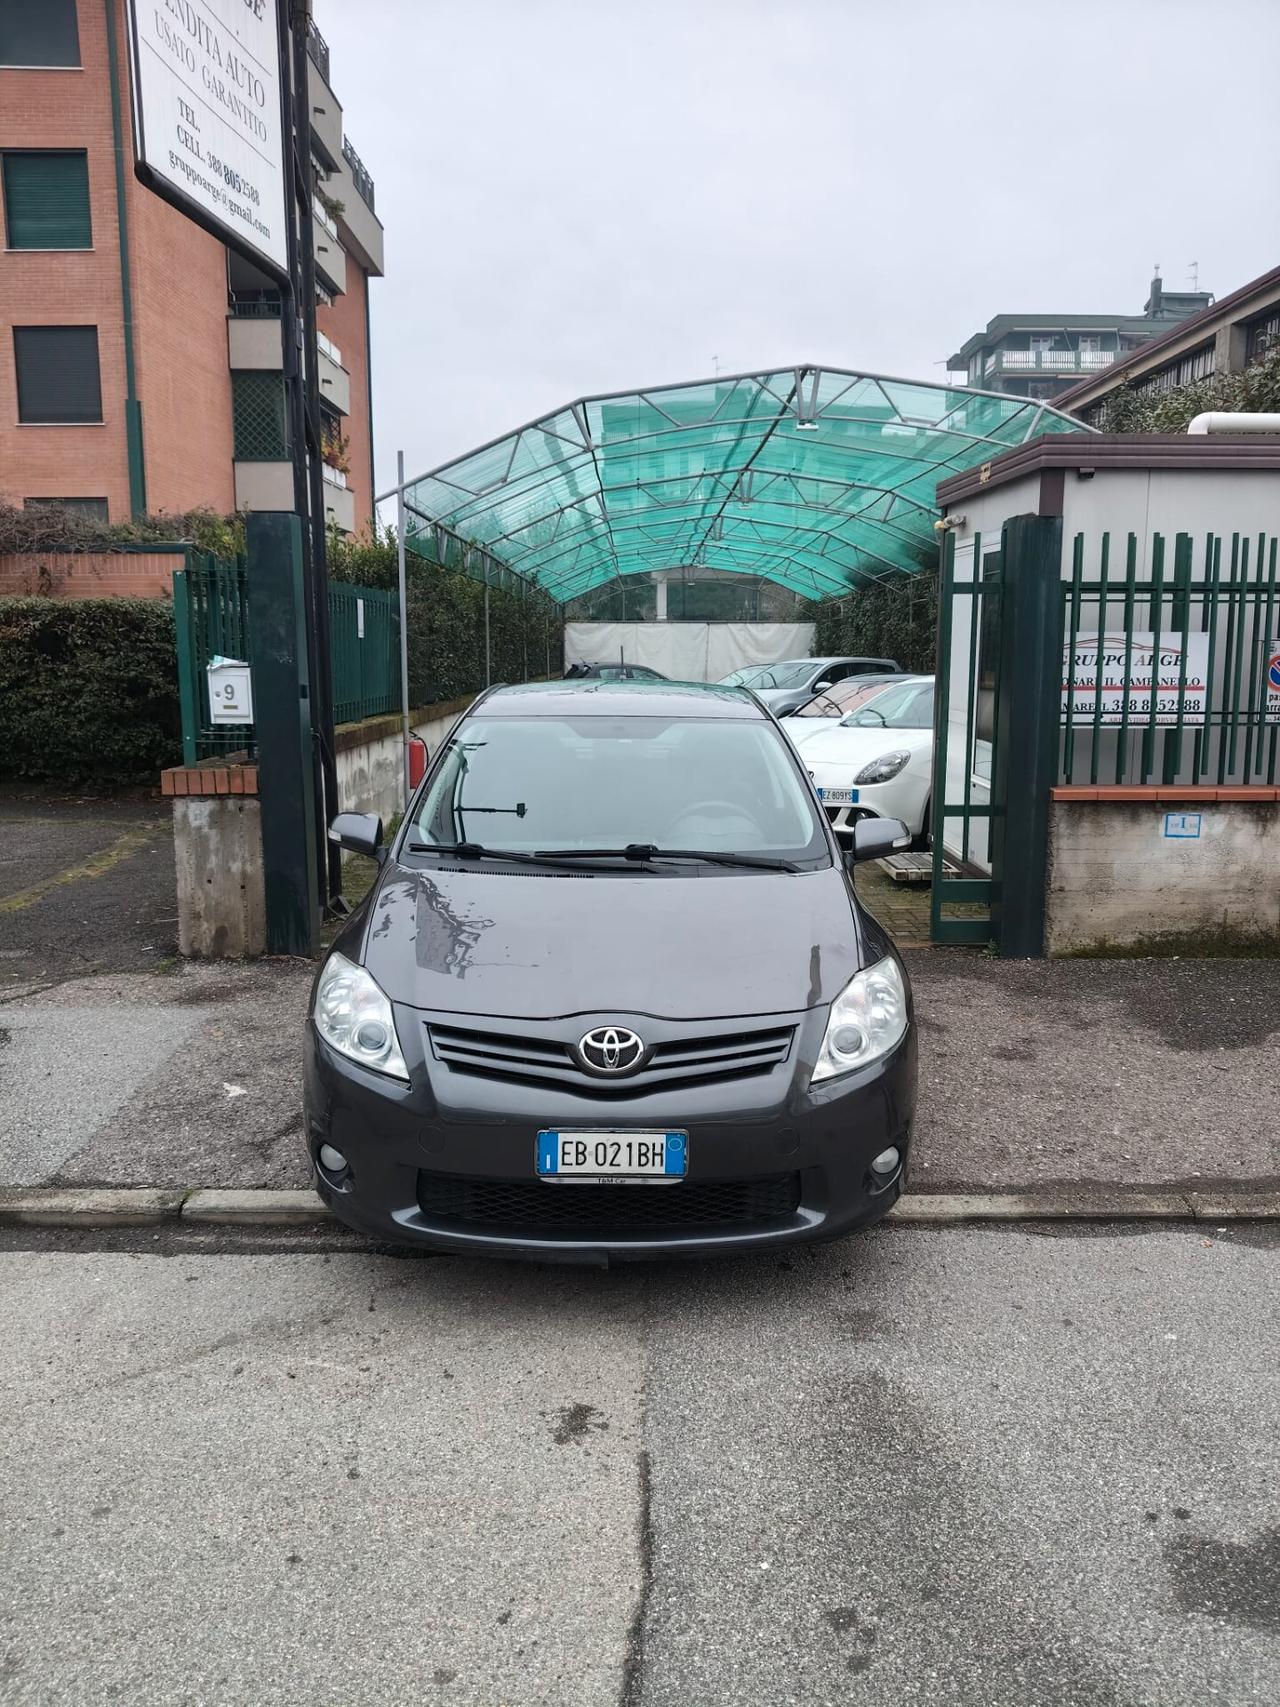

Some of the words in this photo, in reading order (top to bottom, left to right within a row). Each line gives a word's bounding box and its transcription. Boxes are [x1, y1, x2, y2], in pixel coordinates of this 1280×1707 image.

[154, 8, 195, 73] USATO
[202, 64, 267, 142] GARANTITO
[165, 0, 223, 67] NDITA
[225, 50, 265, 108] AUTO
[177, 96, 201, 133] TEL.
[176, 124, 206, 163] CELL.
[206, 151, 223, 177] 388
[168, 149, 271, 239] gruppoarge@gmail.com
[223, 683, 235, 701] 9
[1112, 699, 1138, 711] 38
[561, 1141, 588, 1166] EB
